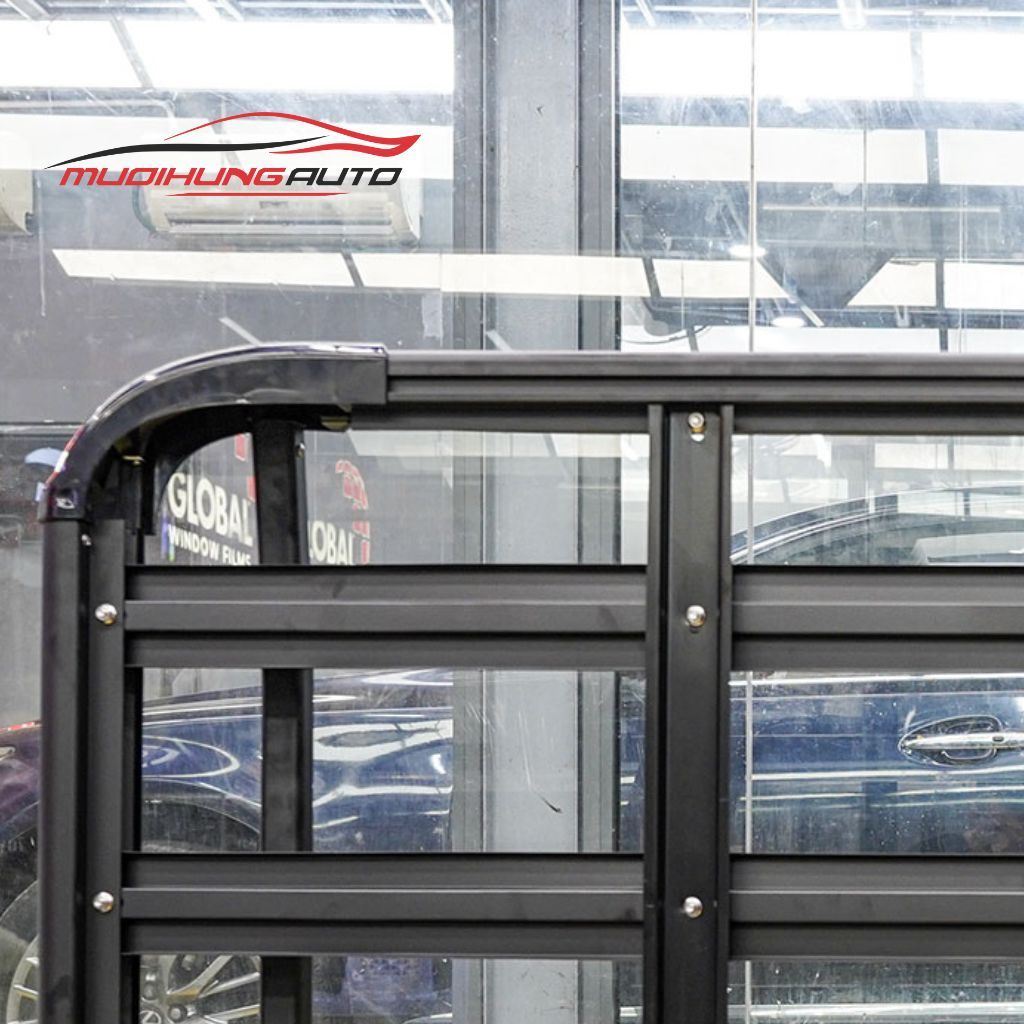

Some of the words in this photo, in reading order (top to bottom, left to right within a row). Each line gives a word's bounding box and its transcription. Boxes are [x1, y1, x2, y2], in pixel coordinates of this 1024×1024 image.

[168, 472, 253, 548] GLOBAL
[168, 523, 221, 561] WINDOW
[222, 543, 252, 566] FILMS
